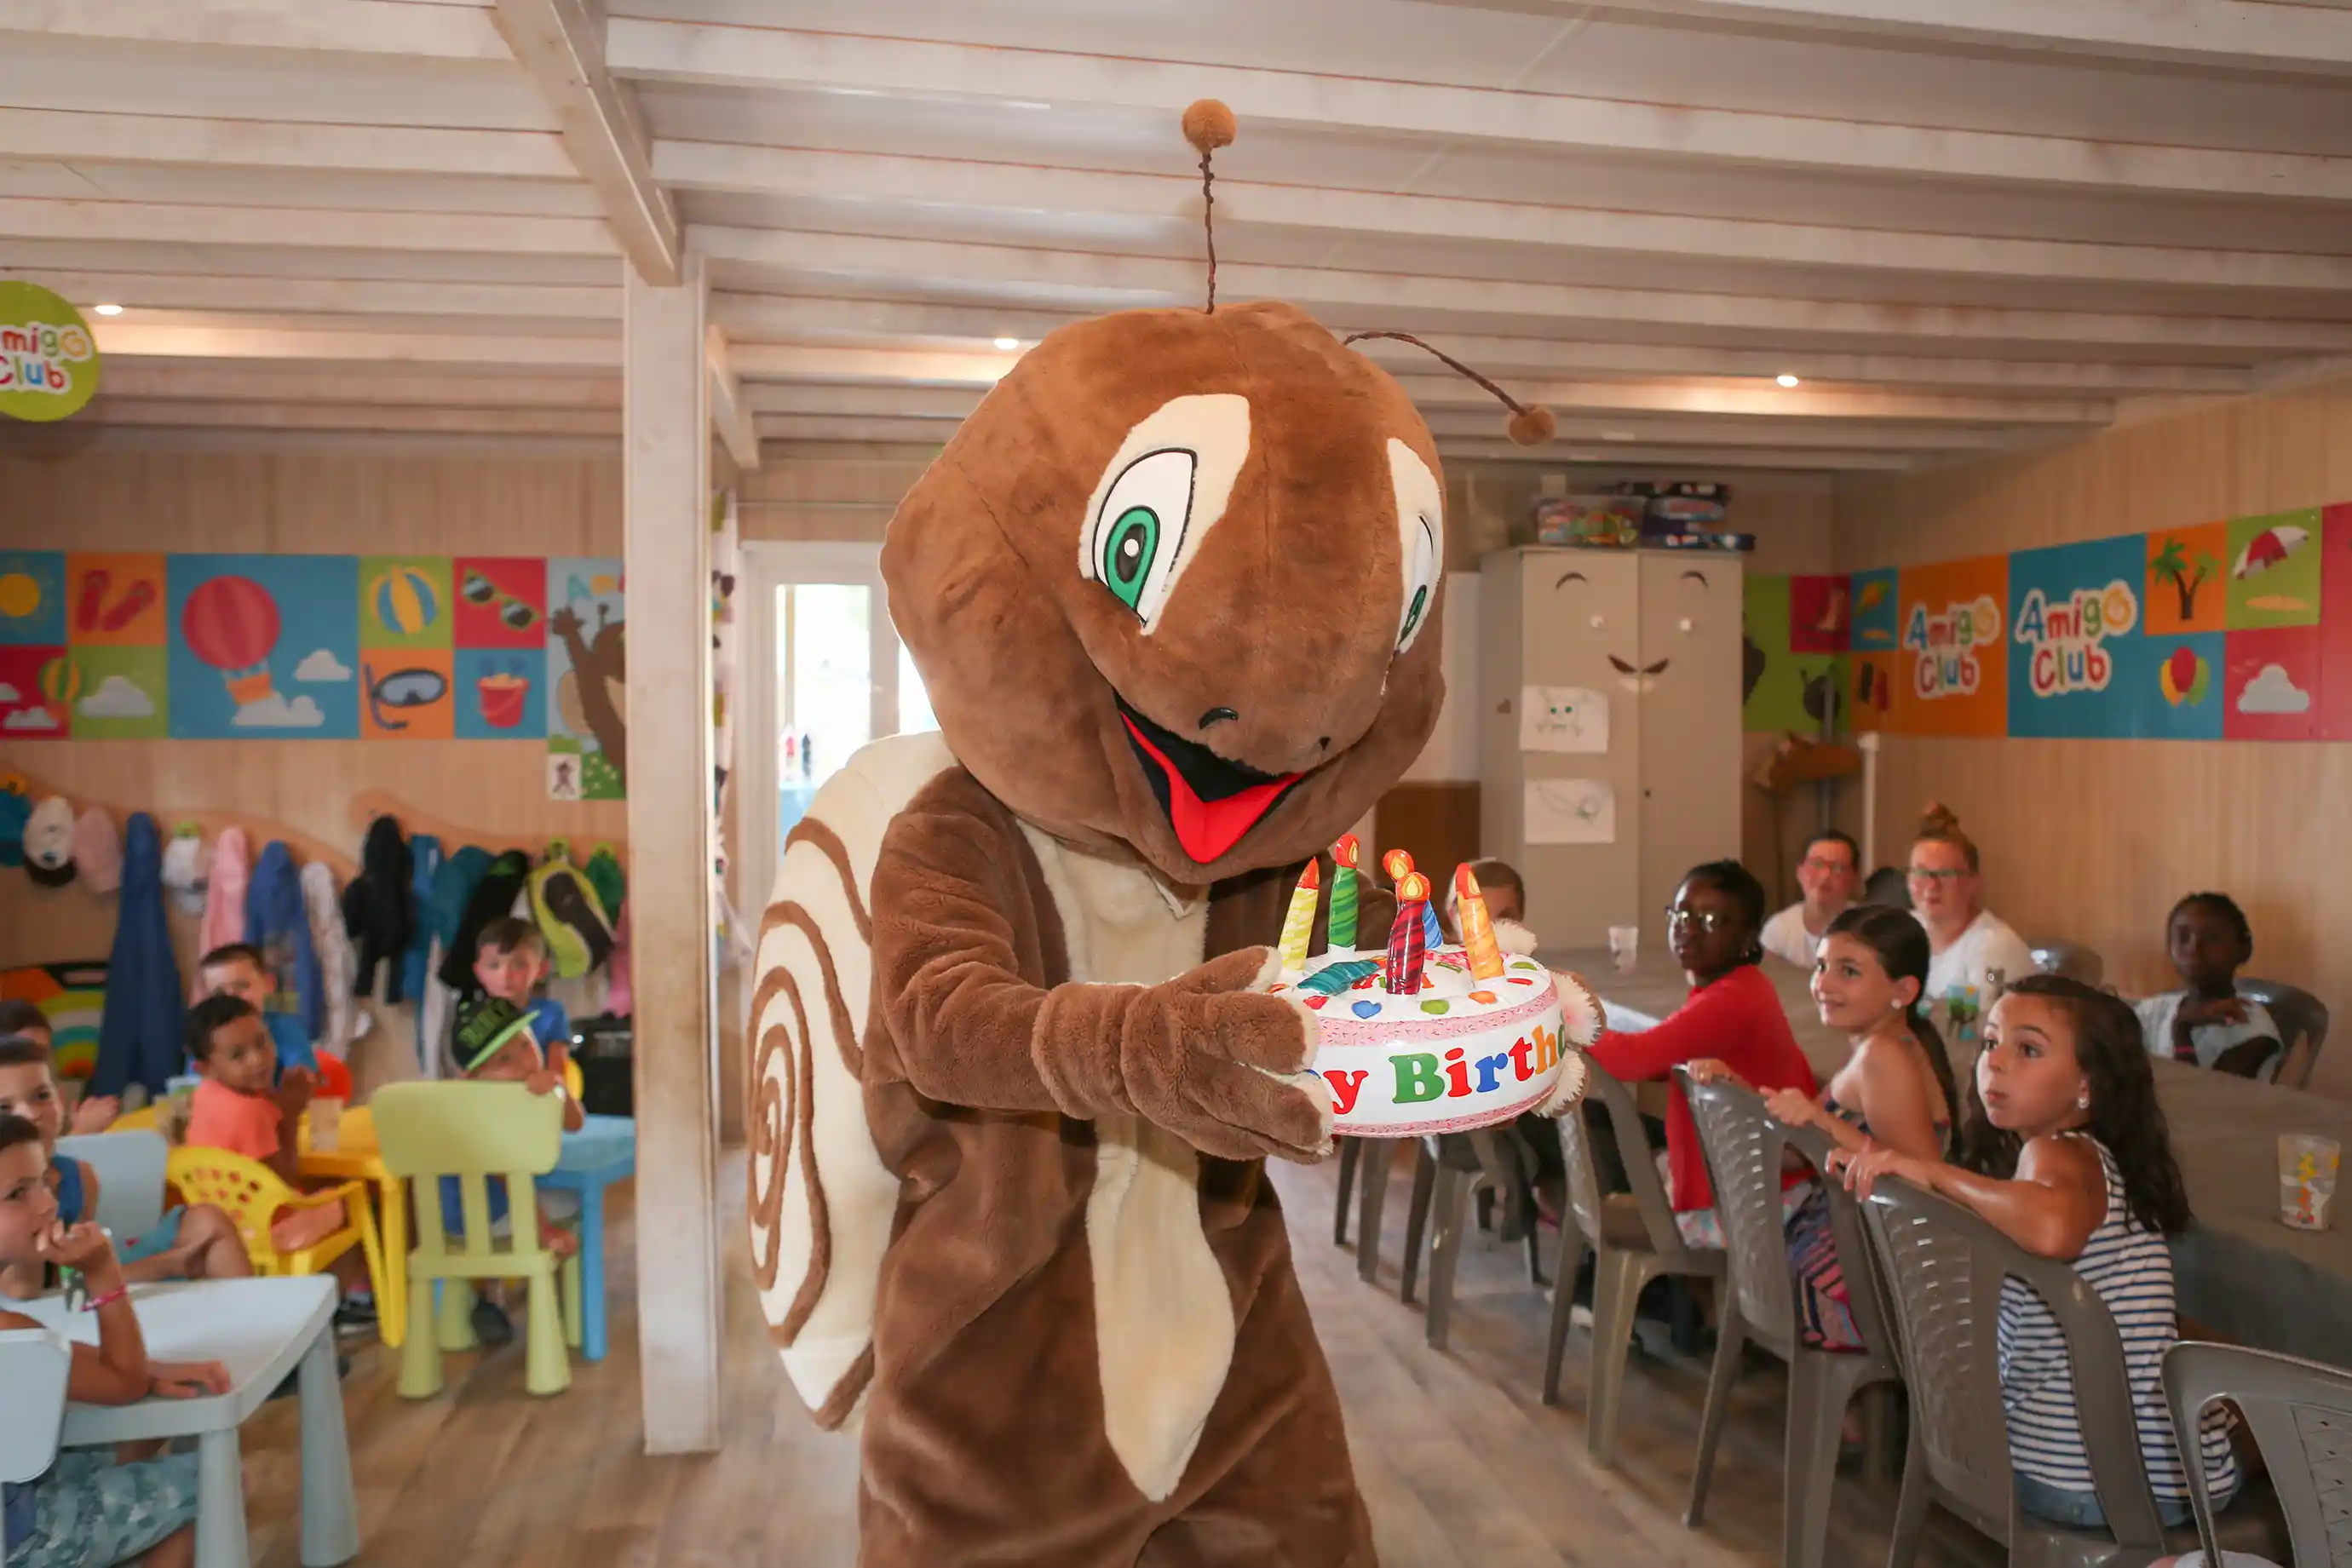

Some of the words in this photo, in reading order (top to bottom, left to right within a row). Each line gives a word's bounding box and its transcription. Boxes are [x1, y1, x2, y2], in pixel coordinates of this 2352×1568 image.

[0, 325, 87, 358] migo
[2020, 589, 2131, 642] Amigo
[1919, 652, 1976, 692] Club
[2034, 644, 2107, 691] Club
[1308, 1069, 1369, 1115] y
